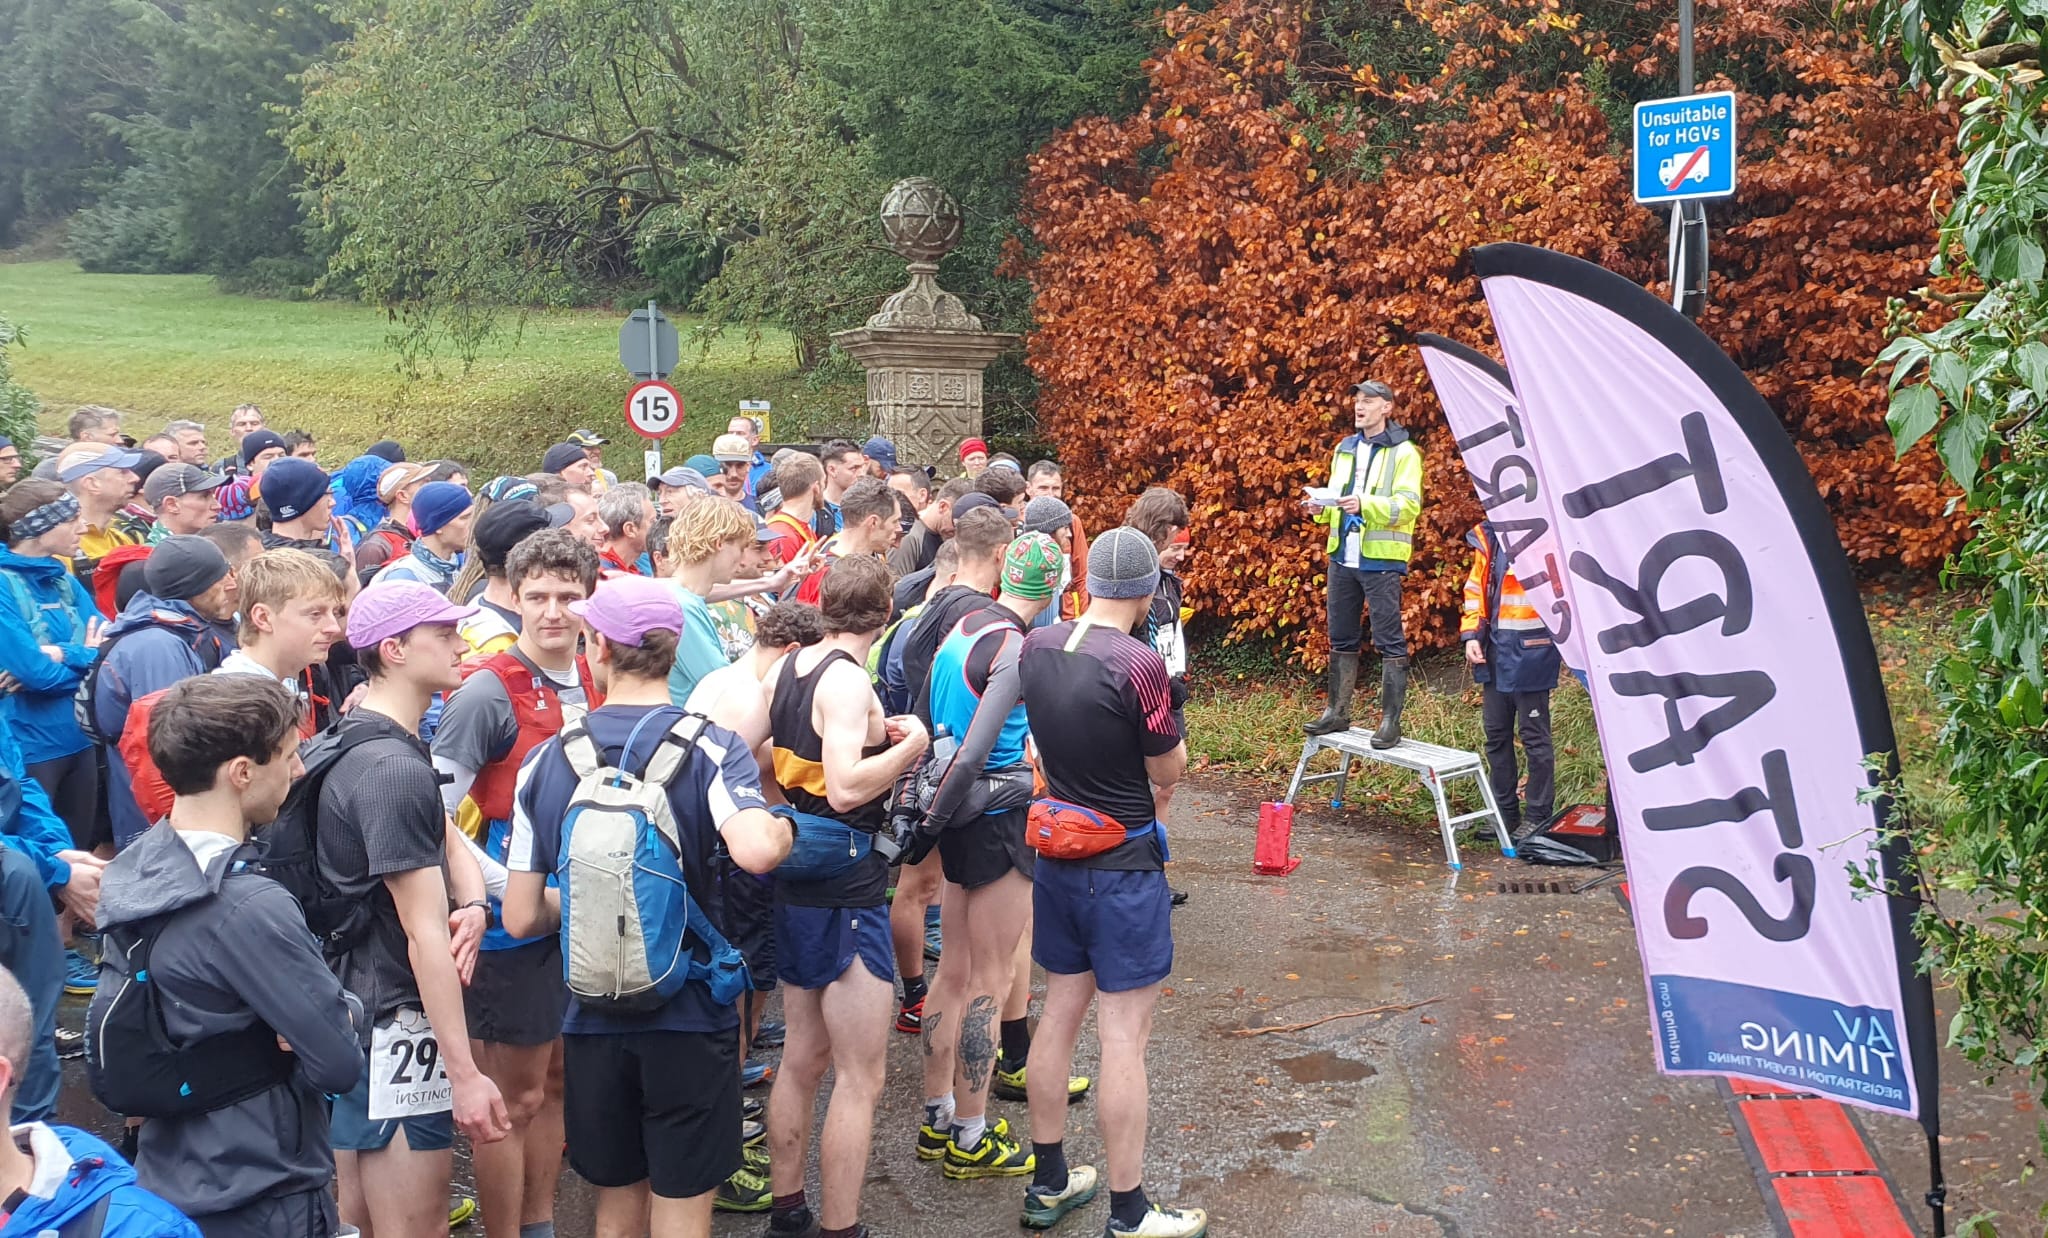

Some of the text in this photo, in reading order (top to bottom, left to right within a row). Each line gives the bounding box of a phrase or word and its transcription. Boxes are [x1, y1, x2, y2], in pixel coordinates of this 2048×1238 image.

[1642, 104, 1727, 128] Unsuitable
[1648, 125, 1720, 147] for HGVs
[636, 396, 670, 421] 15
[389, 1037, 448, 1085] 29
